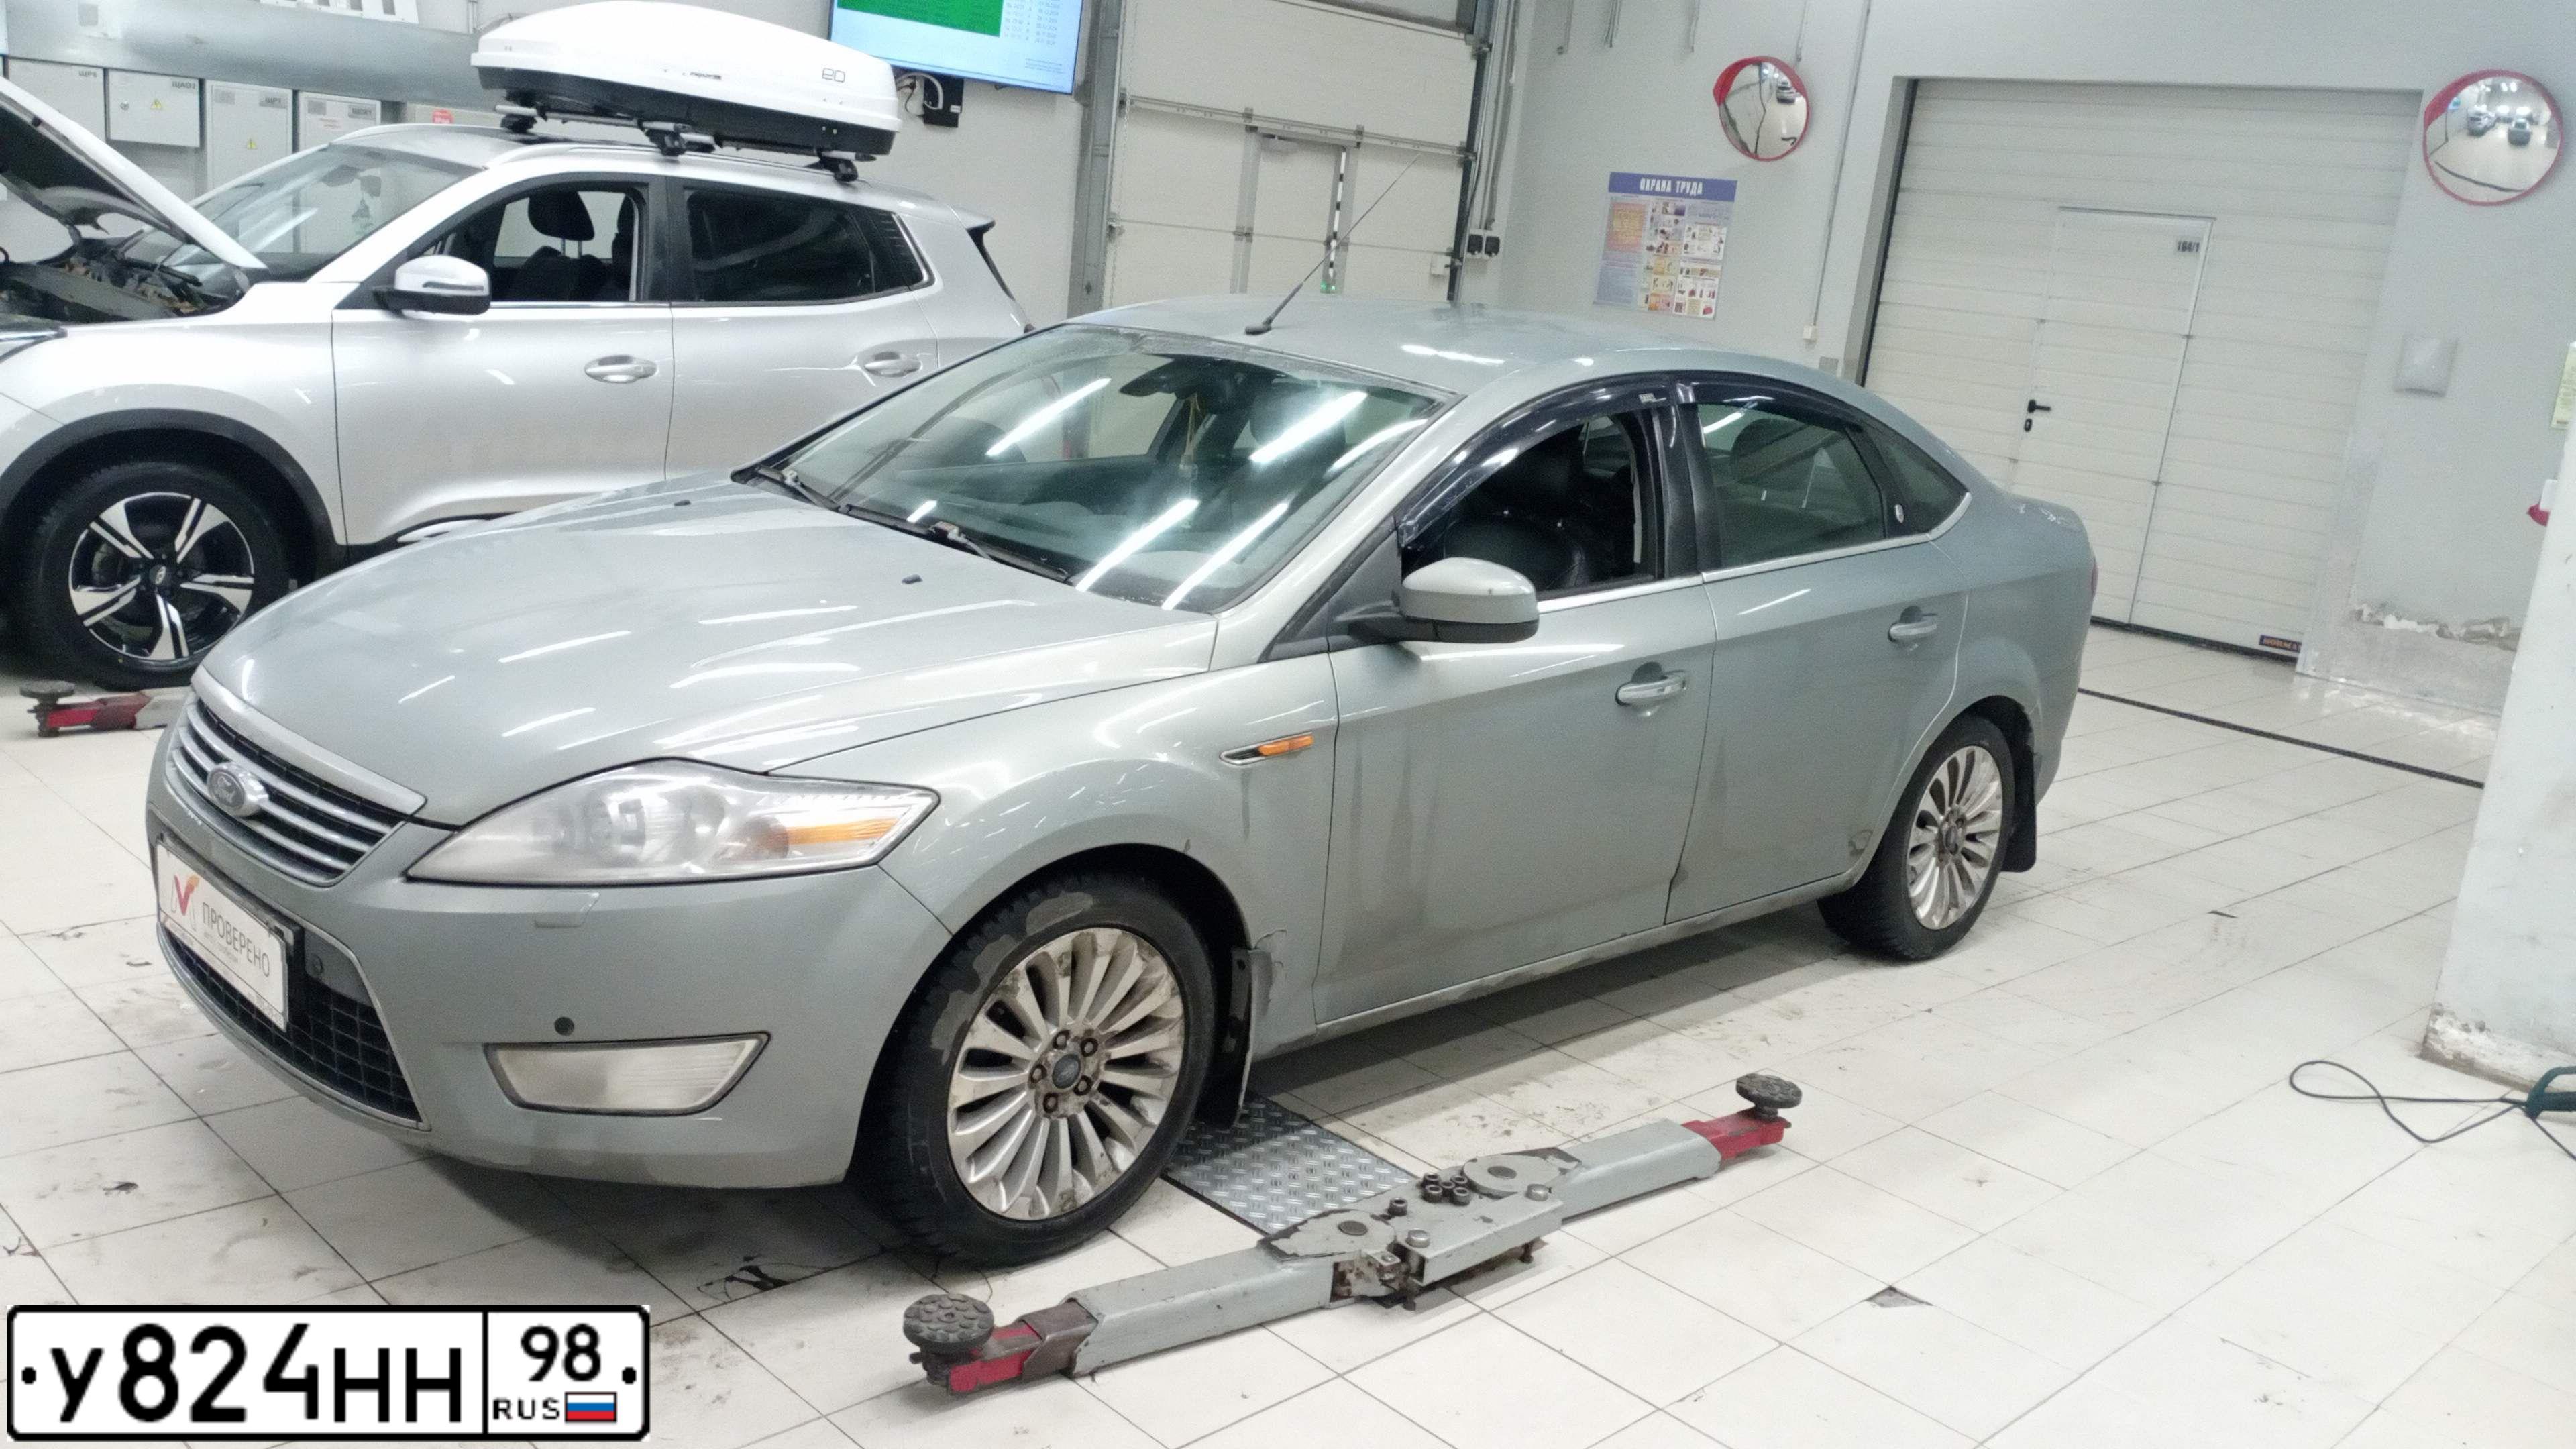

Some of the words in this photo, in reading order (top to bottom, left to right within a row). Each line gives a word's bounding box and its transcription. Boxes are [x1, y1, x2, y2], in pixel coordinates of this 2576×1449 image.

[1640, 178, 1672, 193] ОХРАНА
[1676, 180, 1703, 197] ТРУДА
[202, 902, 270, 977] ПРОВЕРЕНО
